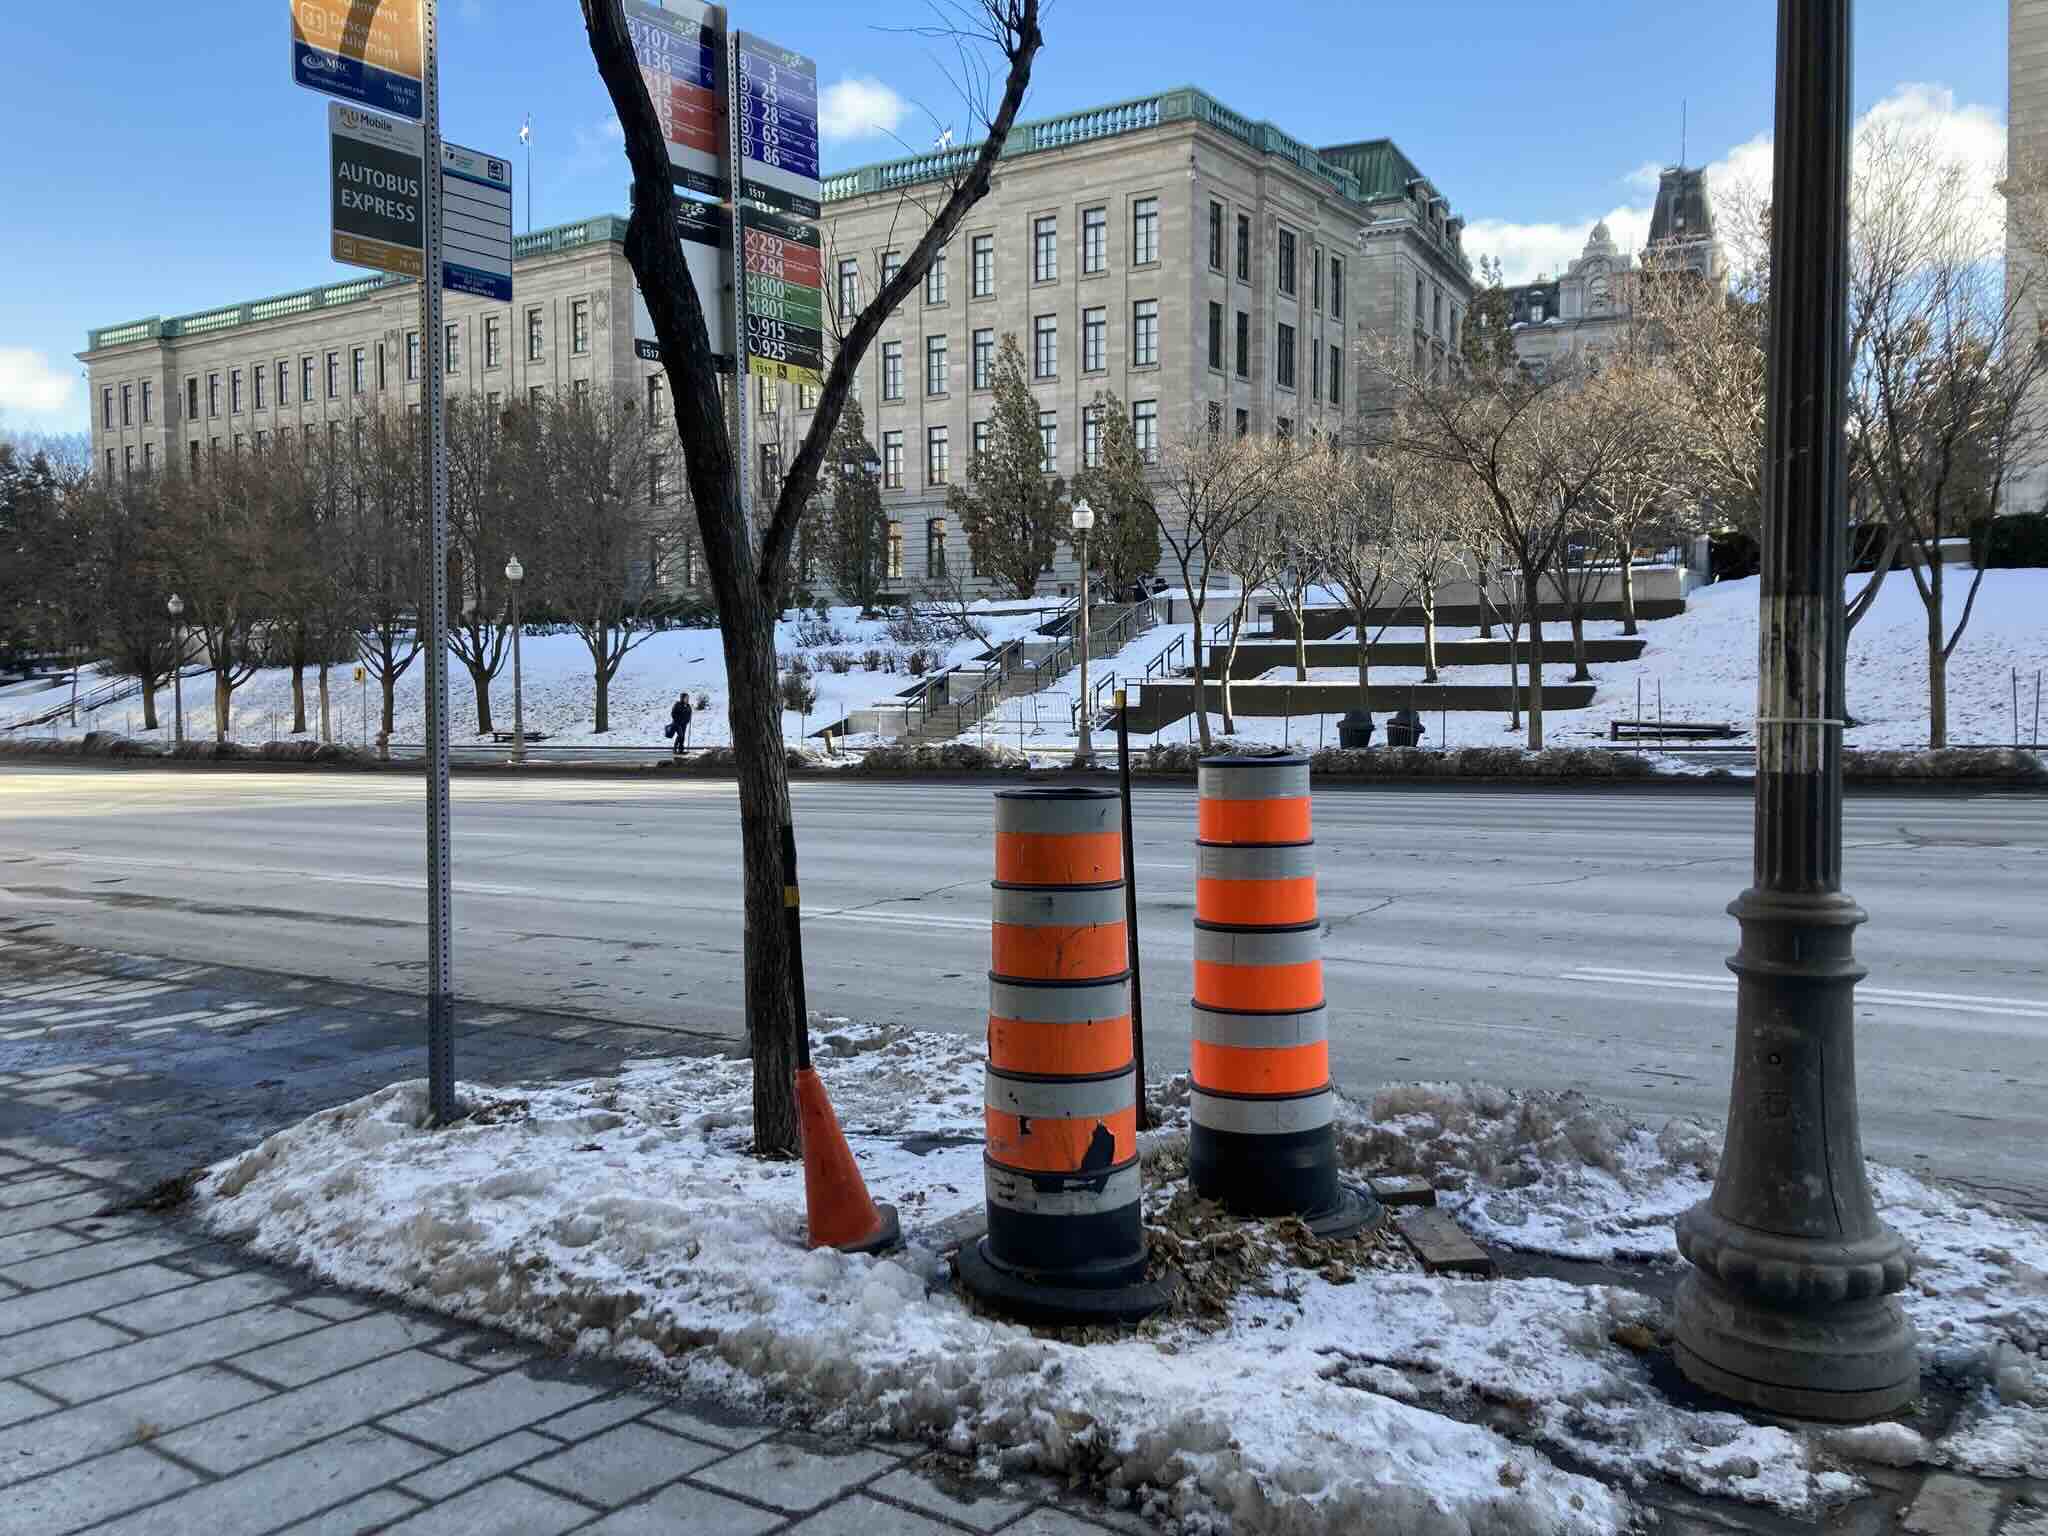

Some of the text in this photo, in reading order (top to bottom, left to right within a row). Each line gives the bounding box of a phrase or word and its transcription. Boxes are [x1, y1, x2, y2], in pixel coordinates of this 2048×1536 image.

[643, 24, 670, 51] 107
[643, 47, 672, 74] 136
[768, 63, 777, 82] 3
[761, 82, 778, 104] 25
[762, 103, 779, 125] 28
[762, 125, 779, 145] 65
[763, 144, 780, 166] 86
[338, 161, 419, 198] AUTOBUS
[748, 187, 766, 199] 1517
[341, 188, 416, 223] EXPRESS
[759, 233, 784, 257] 292
[760, 254, 784, 278] 294
[761, 275, 785, 299] 800
[761, 296, 785, 320] 801
[761, 318, 785, 340] 915
[762, 339, 786, 361] 925
